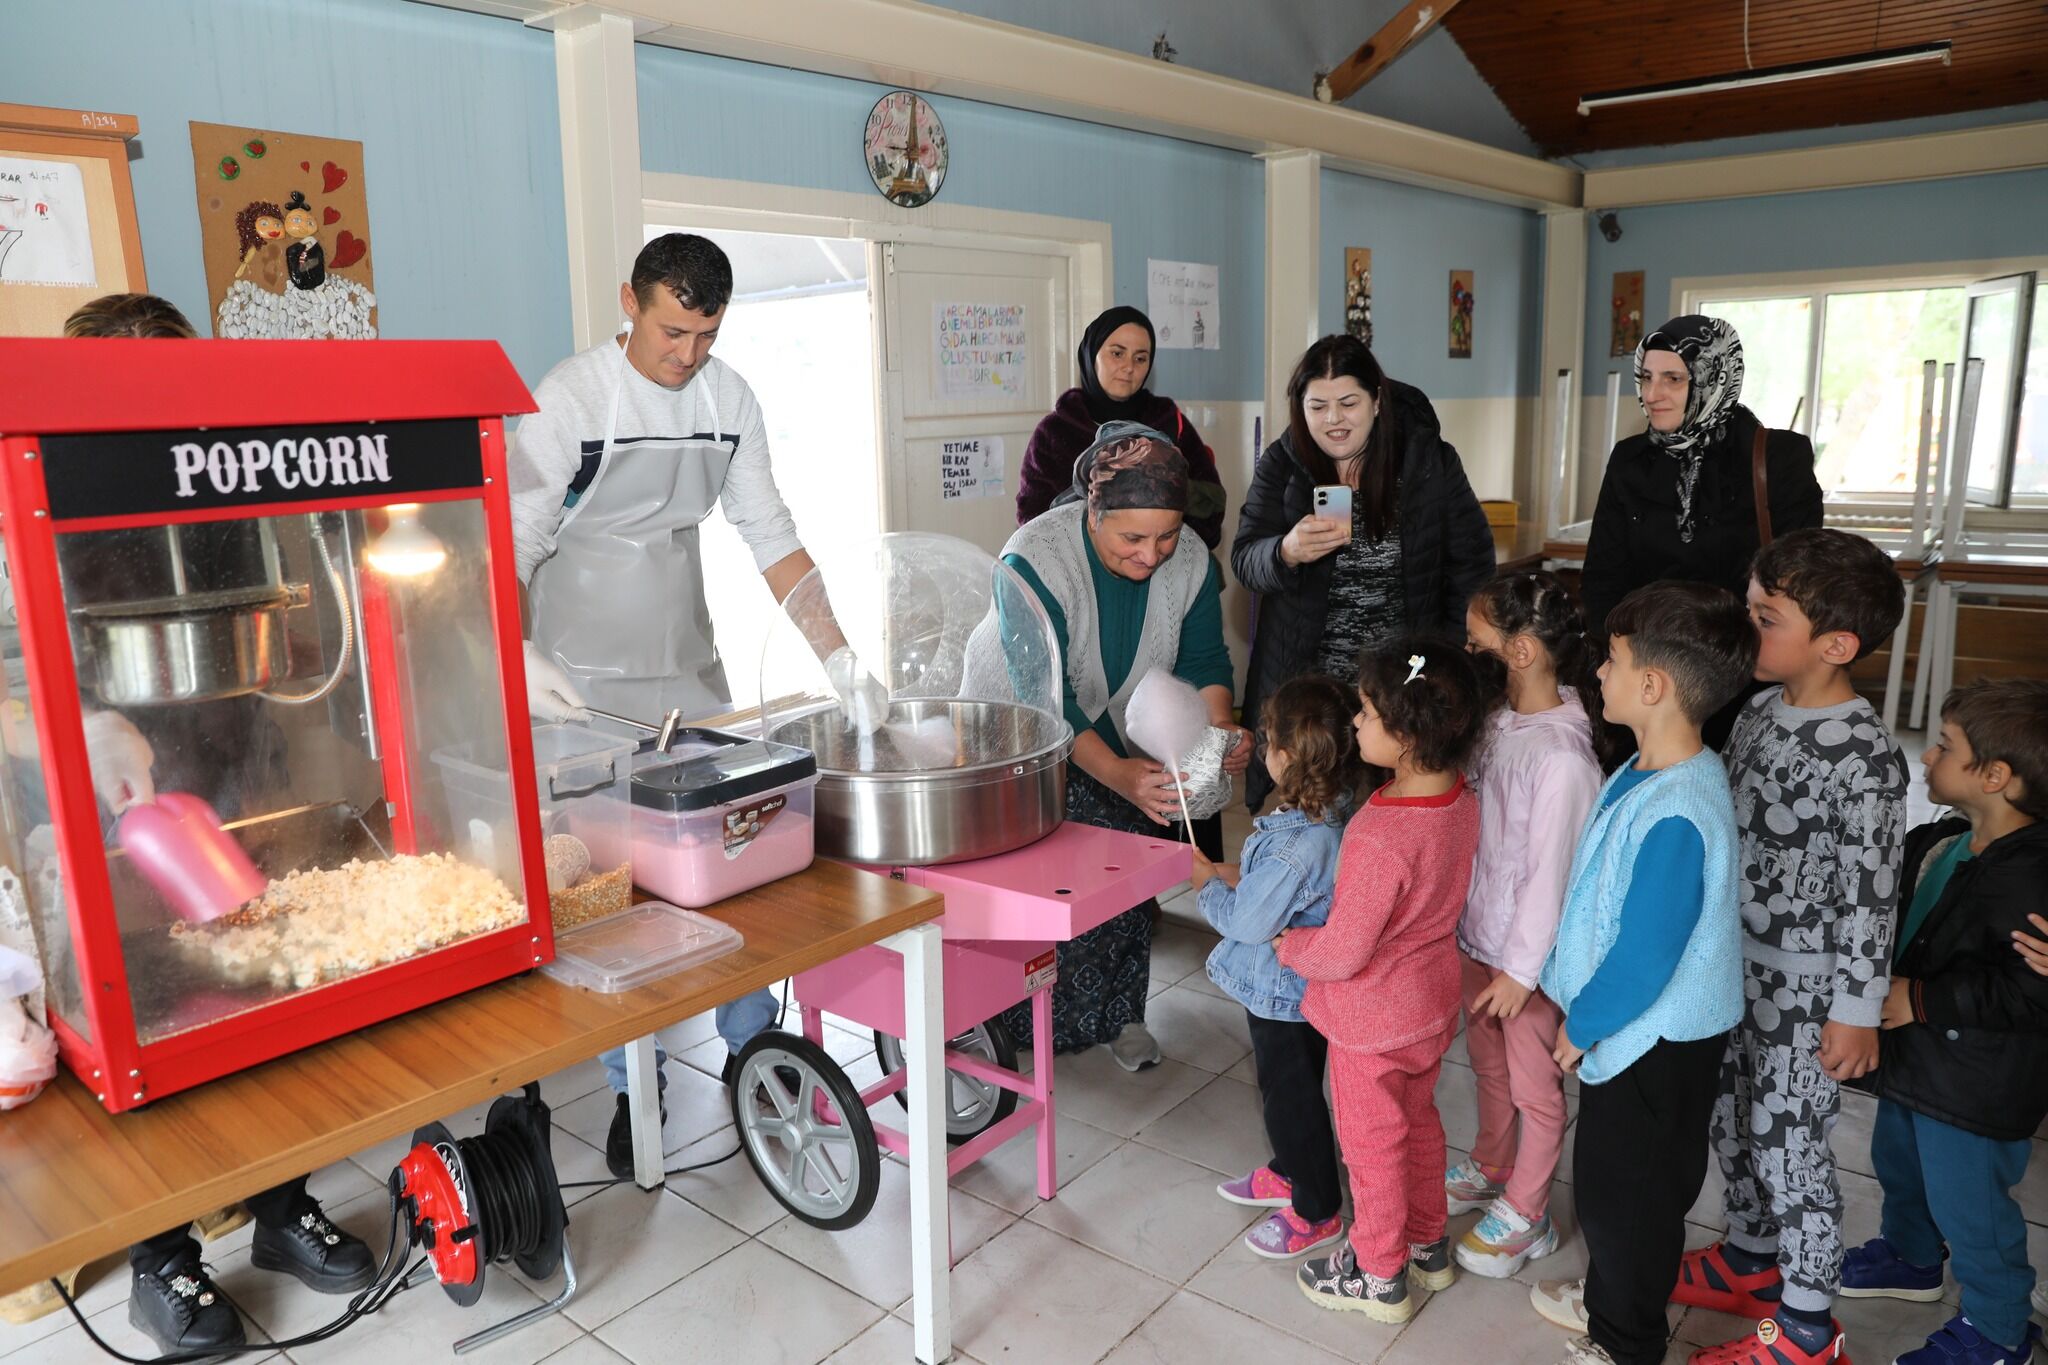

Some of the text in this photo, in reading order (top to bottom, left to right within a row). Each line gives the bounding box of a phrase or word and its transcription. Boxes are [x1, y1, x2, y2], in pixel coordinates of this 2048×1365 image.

[902, 94, 912, 106] 12
[871, 114, 882, 126] 10
[170, 434, 392, 497] POPCORN
